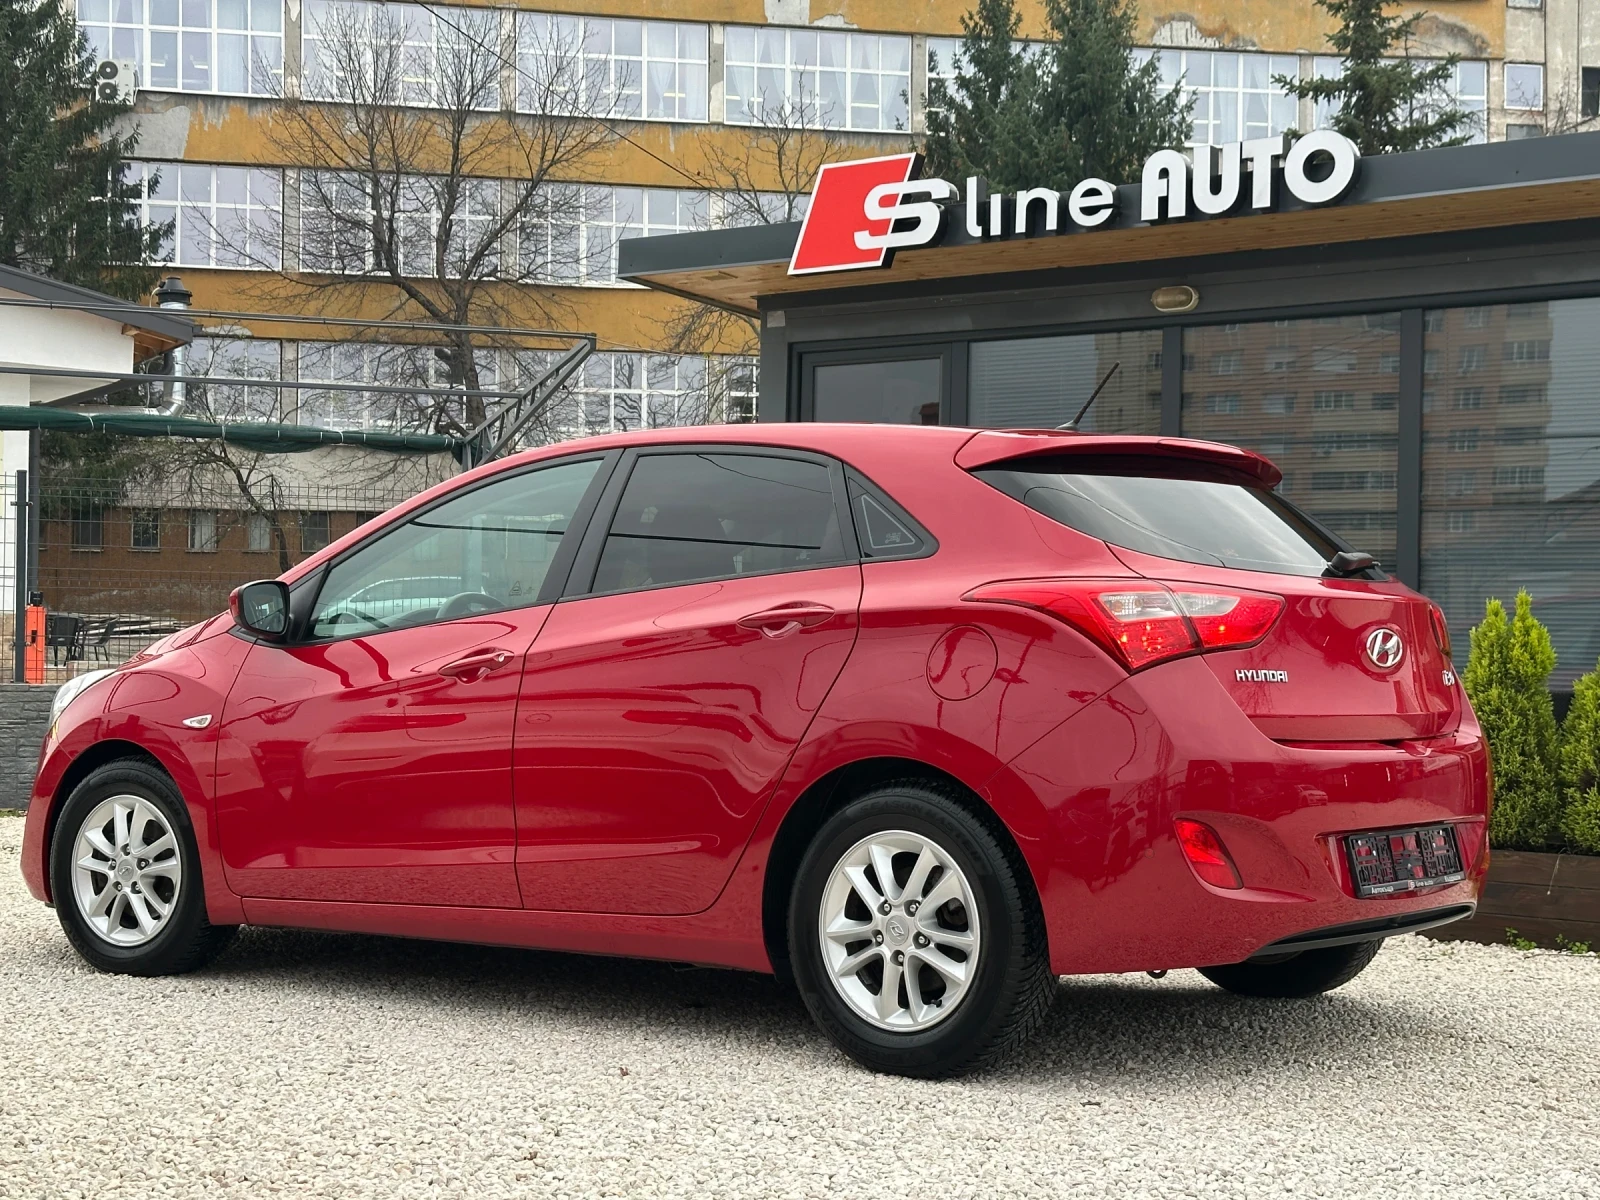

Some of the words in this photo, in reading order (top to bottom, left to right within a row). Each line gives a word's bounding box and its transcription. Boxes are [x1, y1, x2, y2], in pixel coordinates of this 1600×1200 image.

[853, 180, 954, 250] S
[967, 175, 1115, 237] line
[1141, 130, 1354, 220] AUTO
[1235, 669, 1289, 684] HYUNDAI
